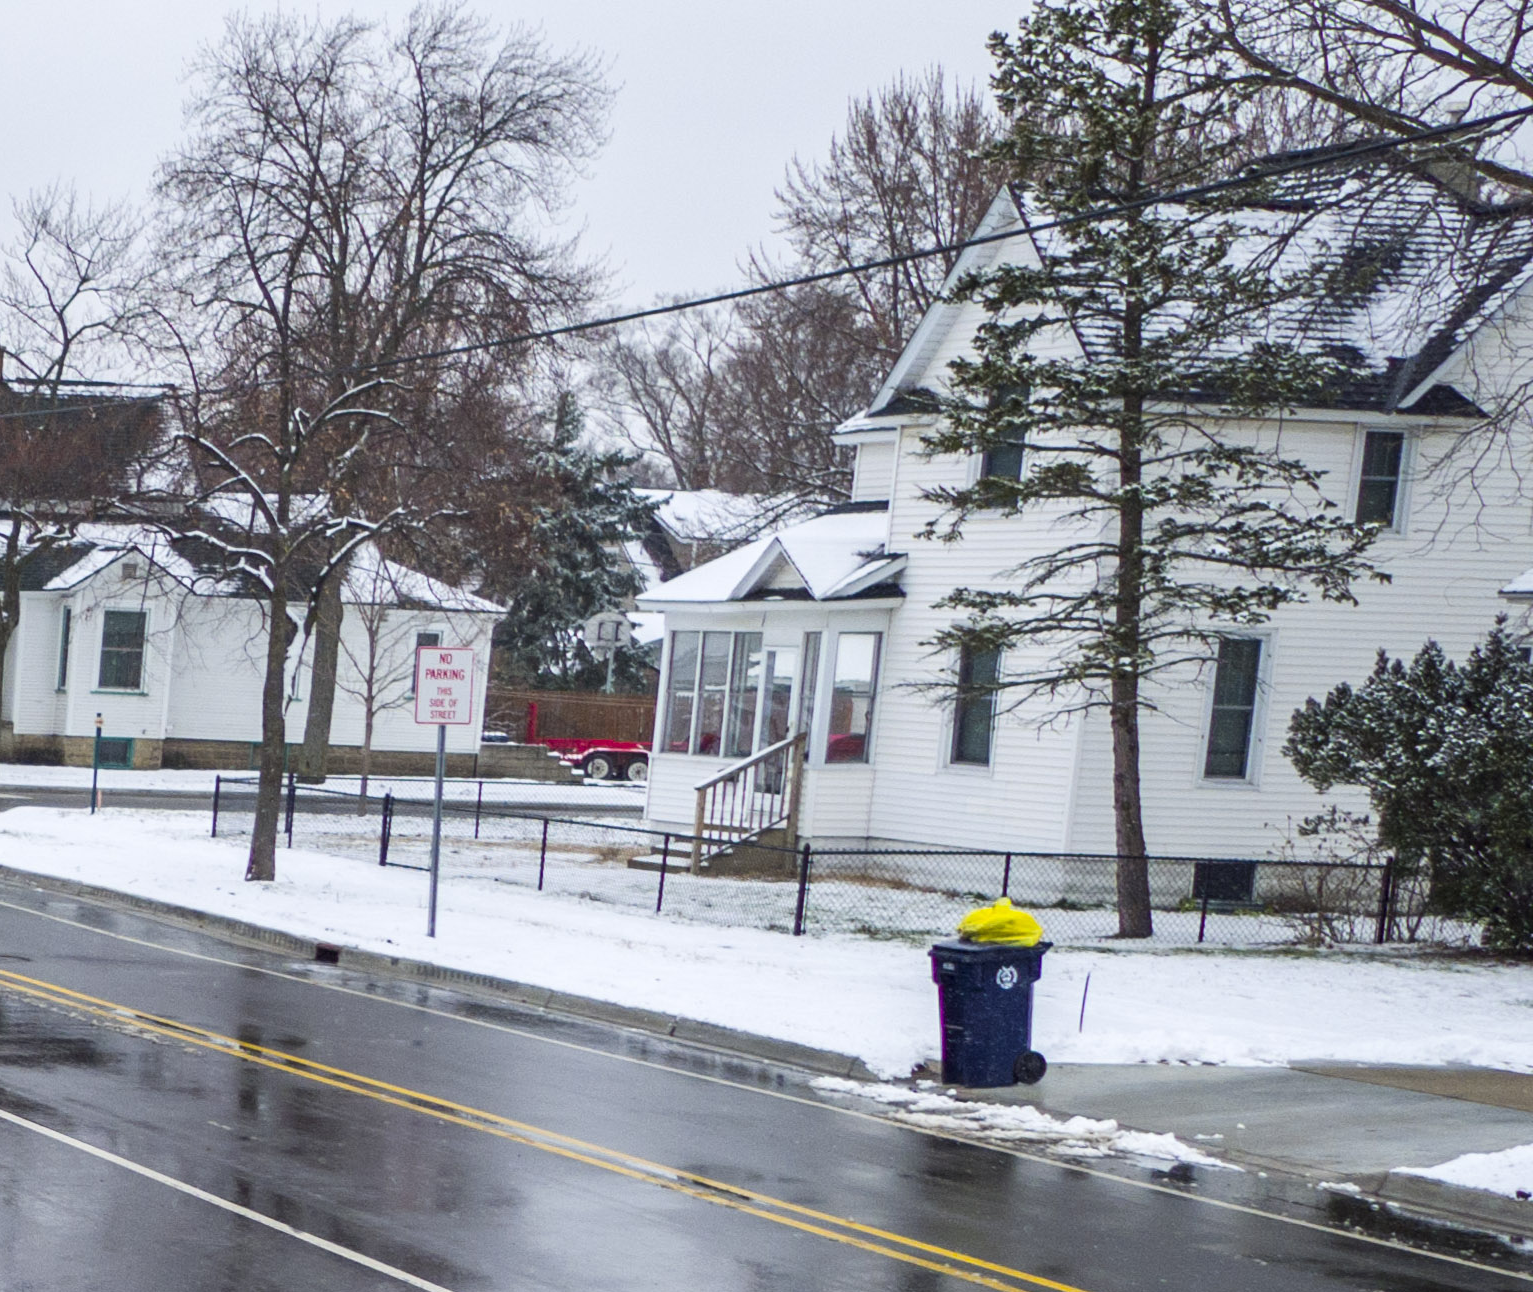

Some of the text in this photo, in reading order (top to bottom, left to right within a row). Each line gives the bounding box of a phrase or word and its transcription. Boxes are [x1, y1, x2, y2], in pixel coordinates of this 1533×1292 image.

[439, 653, 453, 665] NO
[425, 668, 465, 681] PARKING
[437, 686, 453, 696] THIS
[429, 698, 459, 708] SIDE OF
[430, 710, 457, 720] STREET
